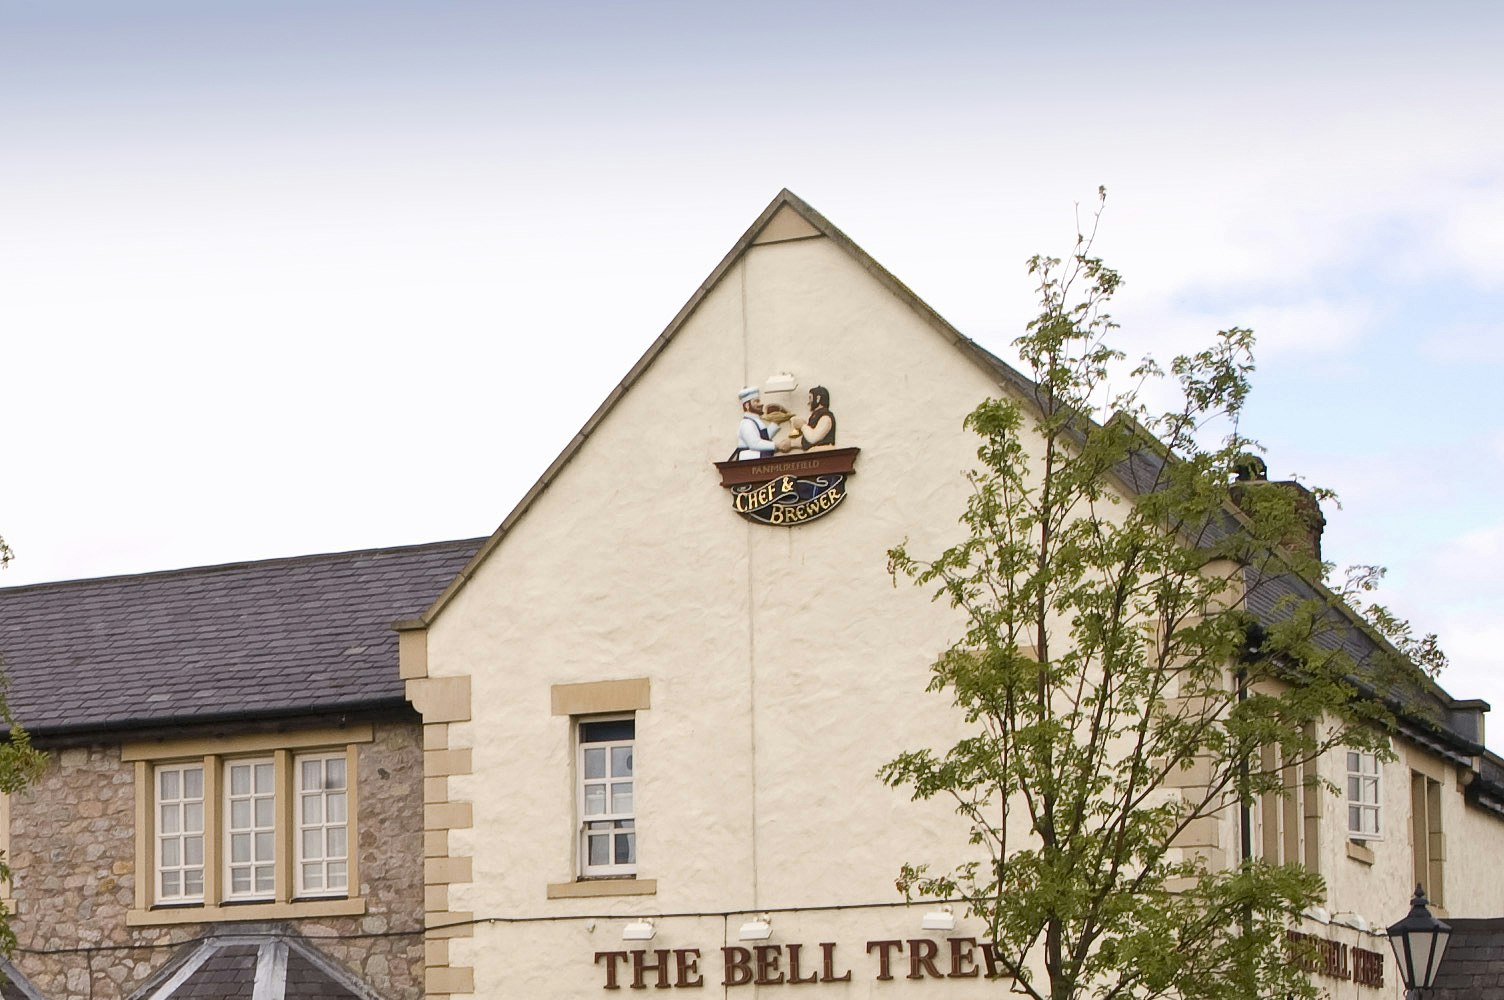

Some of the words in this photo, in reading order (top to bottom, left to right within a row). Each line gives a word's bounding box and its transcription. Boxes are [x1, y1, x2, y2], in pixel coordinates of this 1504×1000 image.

[736, 482, 776, 512] CHEF
[781, 476, 794, 493] &
[770, 488, 841, 524] BREWER
[594, 948, 704, 990] THE
[720, 943, 852, 987] BELL
